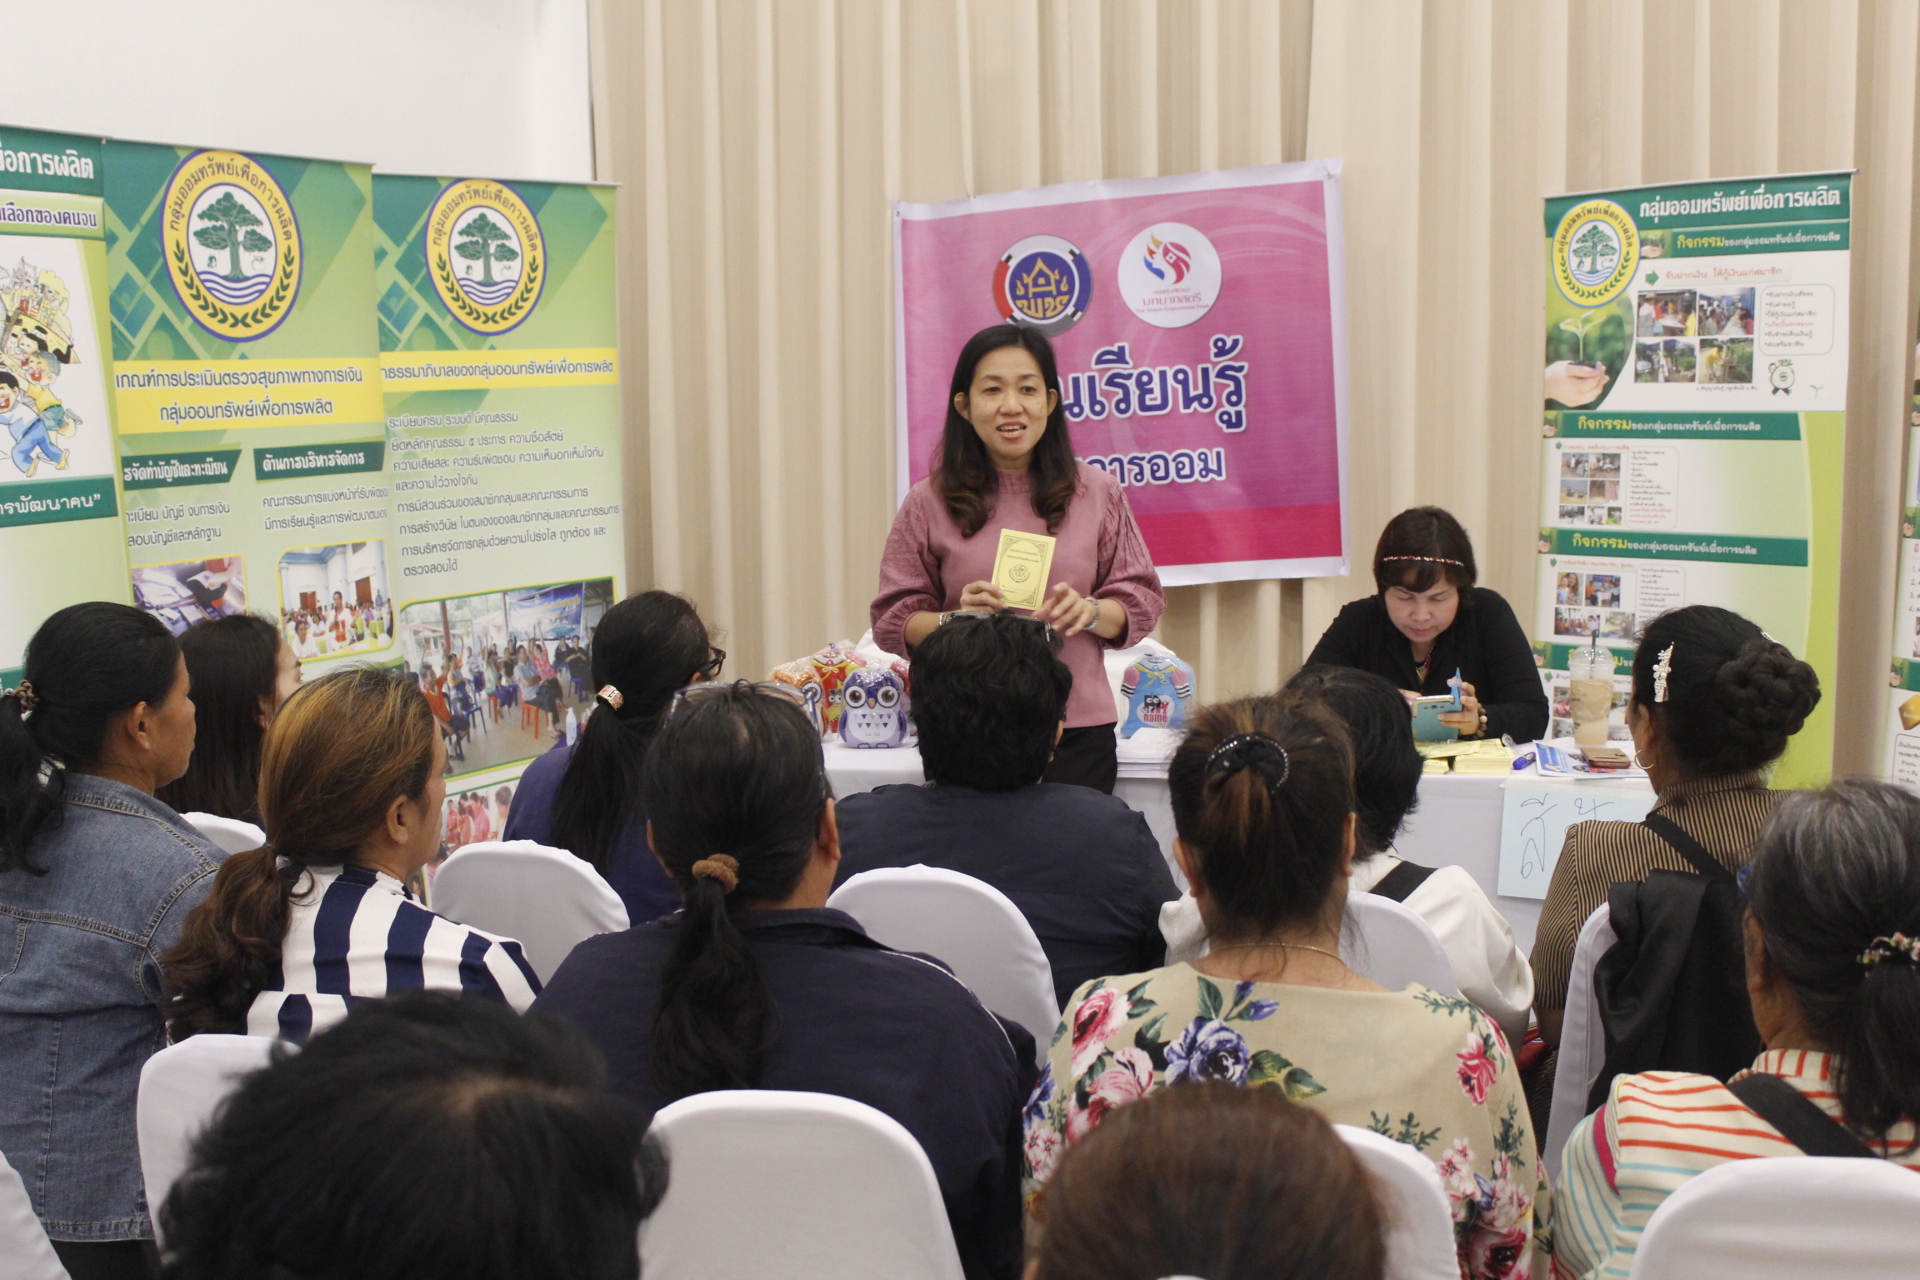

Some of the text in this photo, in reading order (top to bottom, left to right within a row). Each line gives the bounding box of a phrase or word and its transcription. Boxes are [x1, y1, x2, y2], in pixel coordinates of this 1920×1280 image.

[0, 201, 98, 228] เลือกของคนจน
[1639, 183, 1841, 223] กลุ่มออมทรัพย์เพื่อการผลิต
[160, 396, 333, 424] กลุ่มออมทรัพย์เพื่อการผลิต
